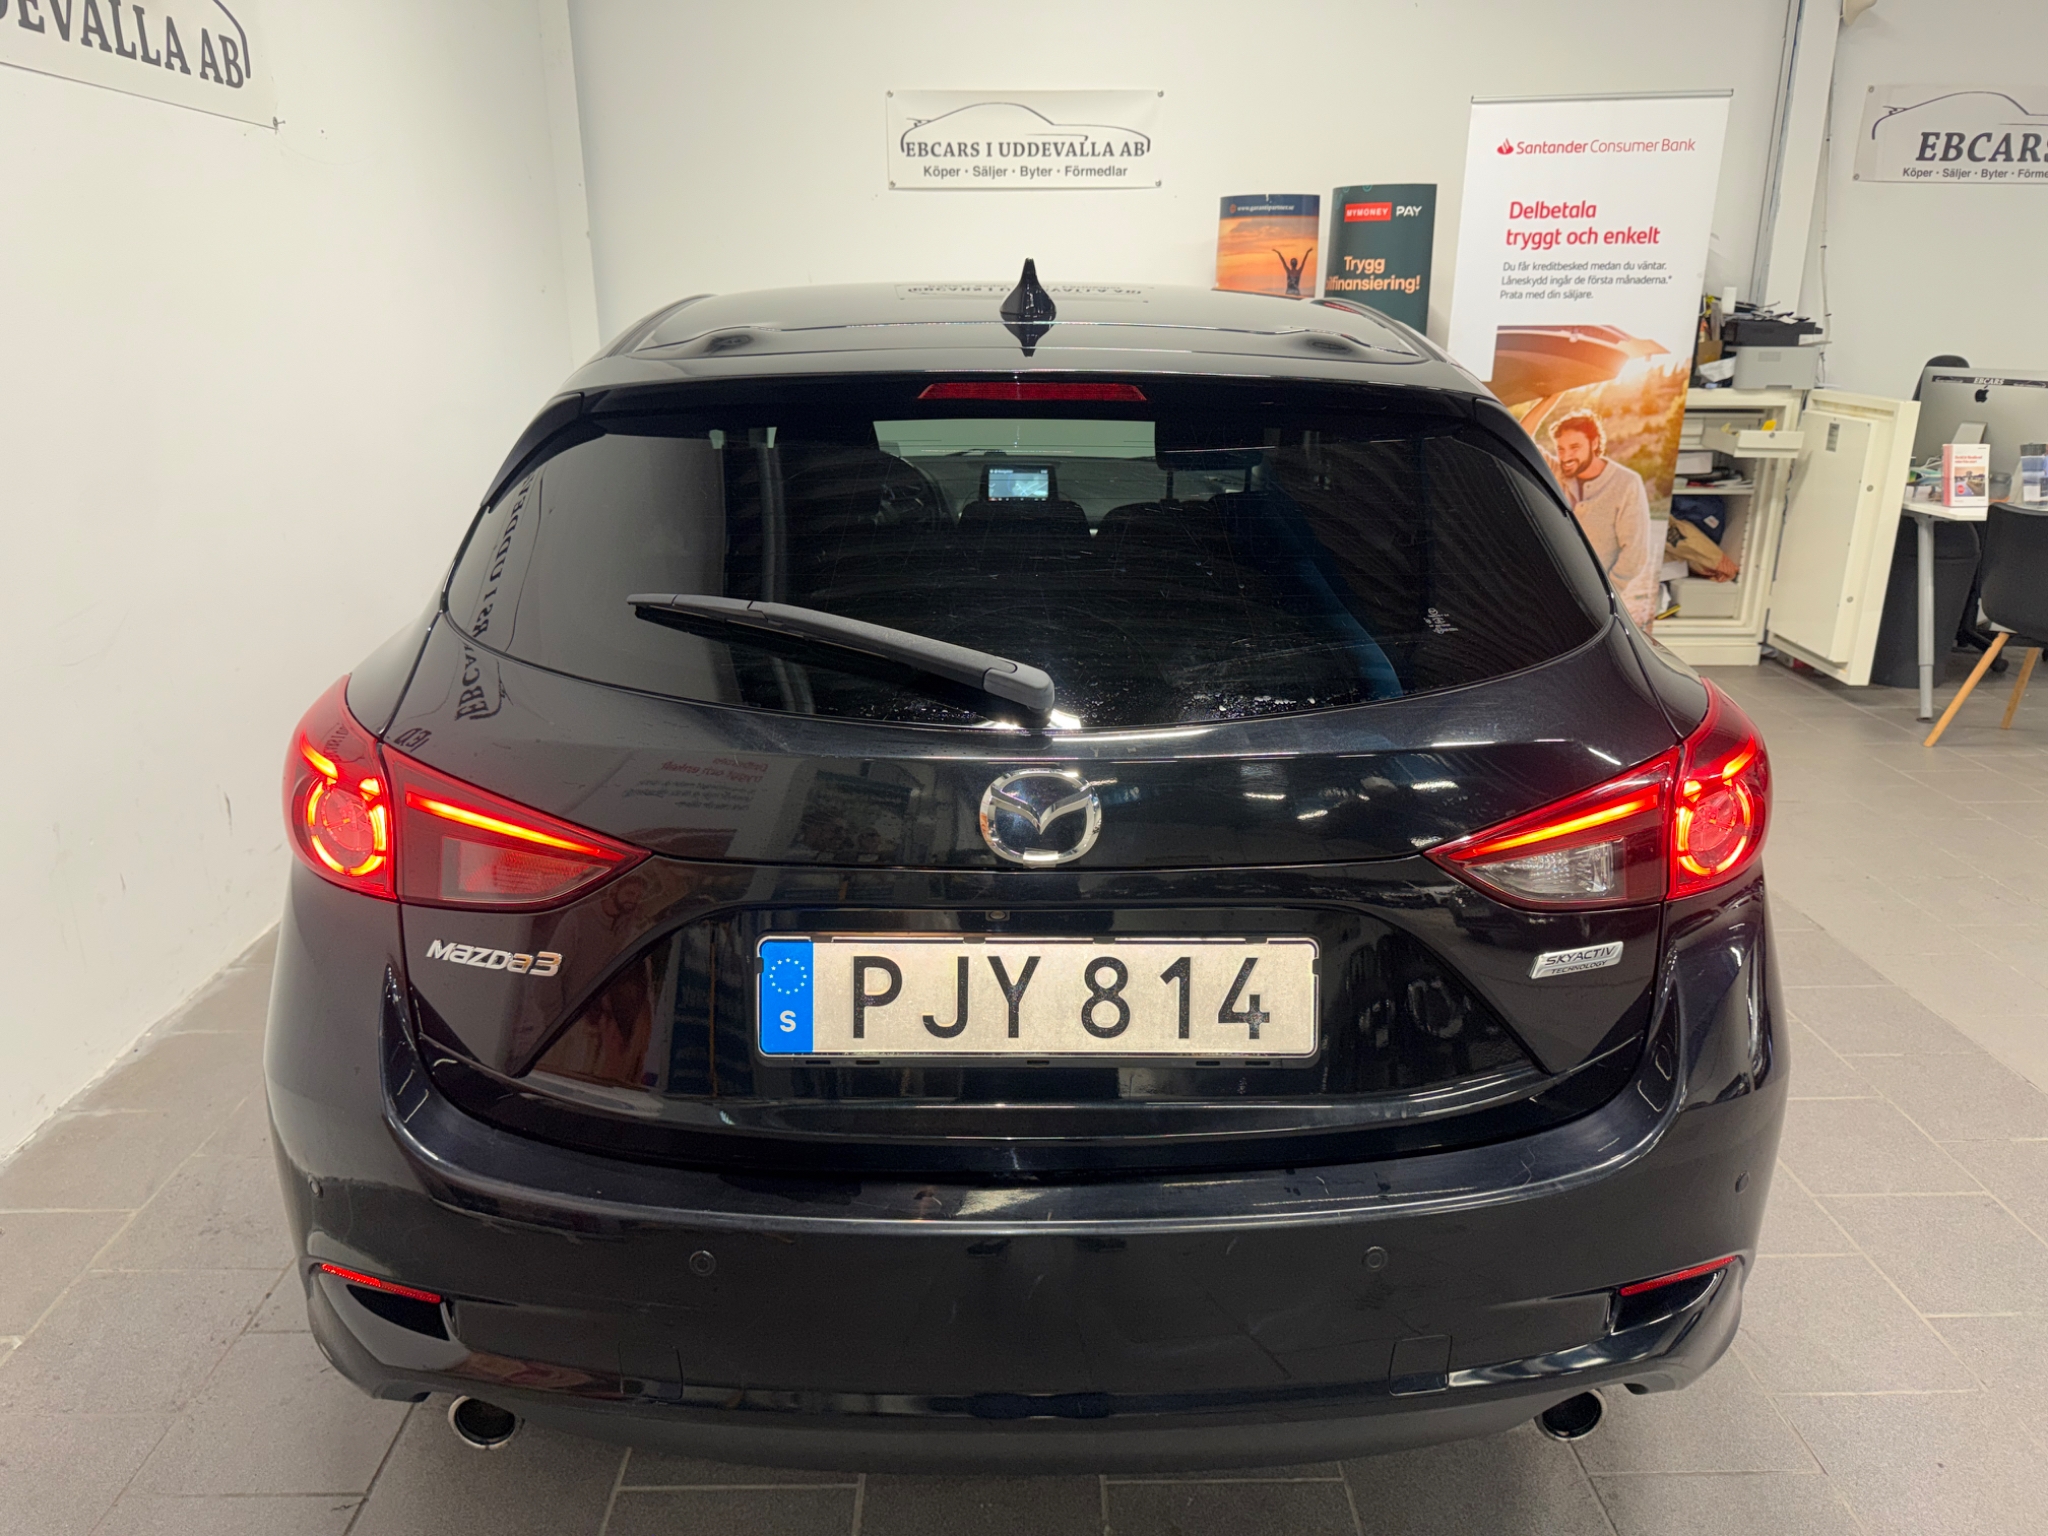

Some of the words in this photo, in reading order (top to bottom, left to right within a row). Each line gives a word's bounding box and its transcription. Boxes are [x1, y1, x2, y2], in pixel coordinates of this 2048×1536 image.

[0, 0, 191, 75] EVALLA
[199, 27, 244, 89] AB
[905, 142, 980, 158] EBCARS
[986, 142, 993, 157] I
[998, 142, 1115, 158] UDDEVALLA
[1120, 142, 1146, 157] AB
[1516, 141, 1588, 155] Santander
[1590, 139, 1659, 153] Consumer
[1661, 138, 1696, 152] Bank
[1915, 131, 2048, 163] EBCAR
[923, 165, 961, 179] Köper
[973, 164, 1008, 179] Säljer
[1020, 165, 1053, 179] Byter
[1065, 164, 1128, 178] Förmedlar
[1902, 167, 1933, 179] Köper
[1942, 168, 1971, 180] Säljer
[1980, 168, 2008, 180] Byter
[1346, 207, 1389, 217] MYMONEY
[1395, 205, 1422, 218] PAY
[1509, 200, 1597, 220] Delbetala
[1505, 228, 1562, 251] tryggt
[1566, 227, 1598, 245] och
[1603, 226, 1661, 245] enkelt
[1343, 255, 1385, 274] Trygg
[1502, 262, 1516, 271] Du
[1518, 261, 1530, 271] får
[1532, 261, 1588, 271] kreditbesked
[1590, 261, 1621, 271] medan
[1623, 261, 1635, 271] du
[1637, 261, 1667, 271] väntar.
[1501, 275, 1548, 288] Låneskydd
[1550, 275, 1572, 287] ingår
[1574, 275, 1585, 285] de
[1587, 275, 1613, 286] första
[1500, 290, 1523, 300] Prata
[1525, 290, 1545, 300] med
[1547, 290, 1561, 299] din
[1563, 289, 1594, 301] säljare.
[1973, 377, 2005, 385] EBCARS
[1545, 946, 1616, 966] SKYACTIV
[1551, 960, 1608, 974] TECHNOLOGY
[852, 955, 1041, 1039] PJY
[1081, 955, 1271, 1039] 814
[779, 1009, 797, 1033] S
